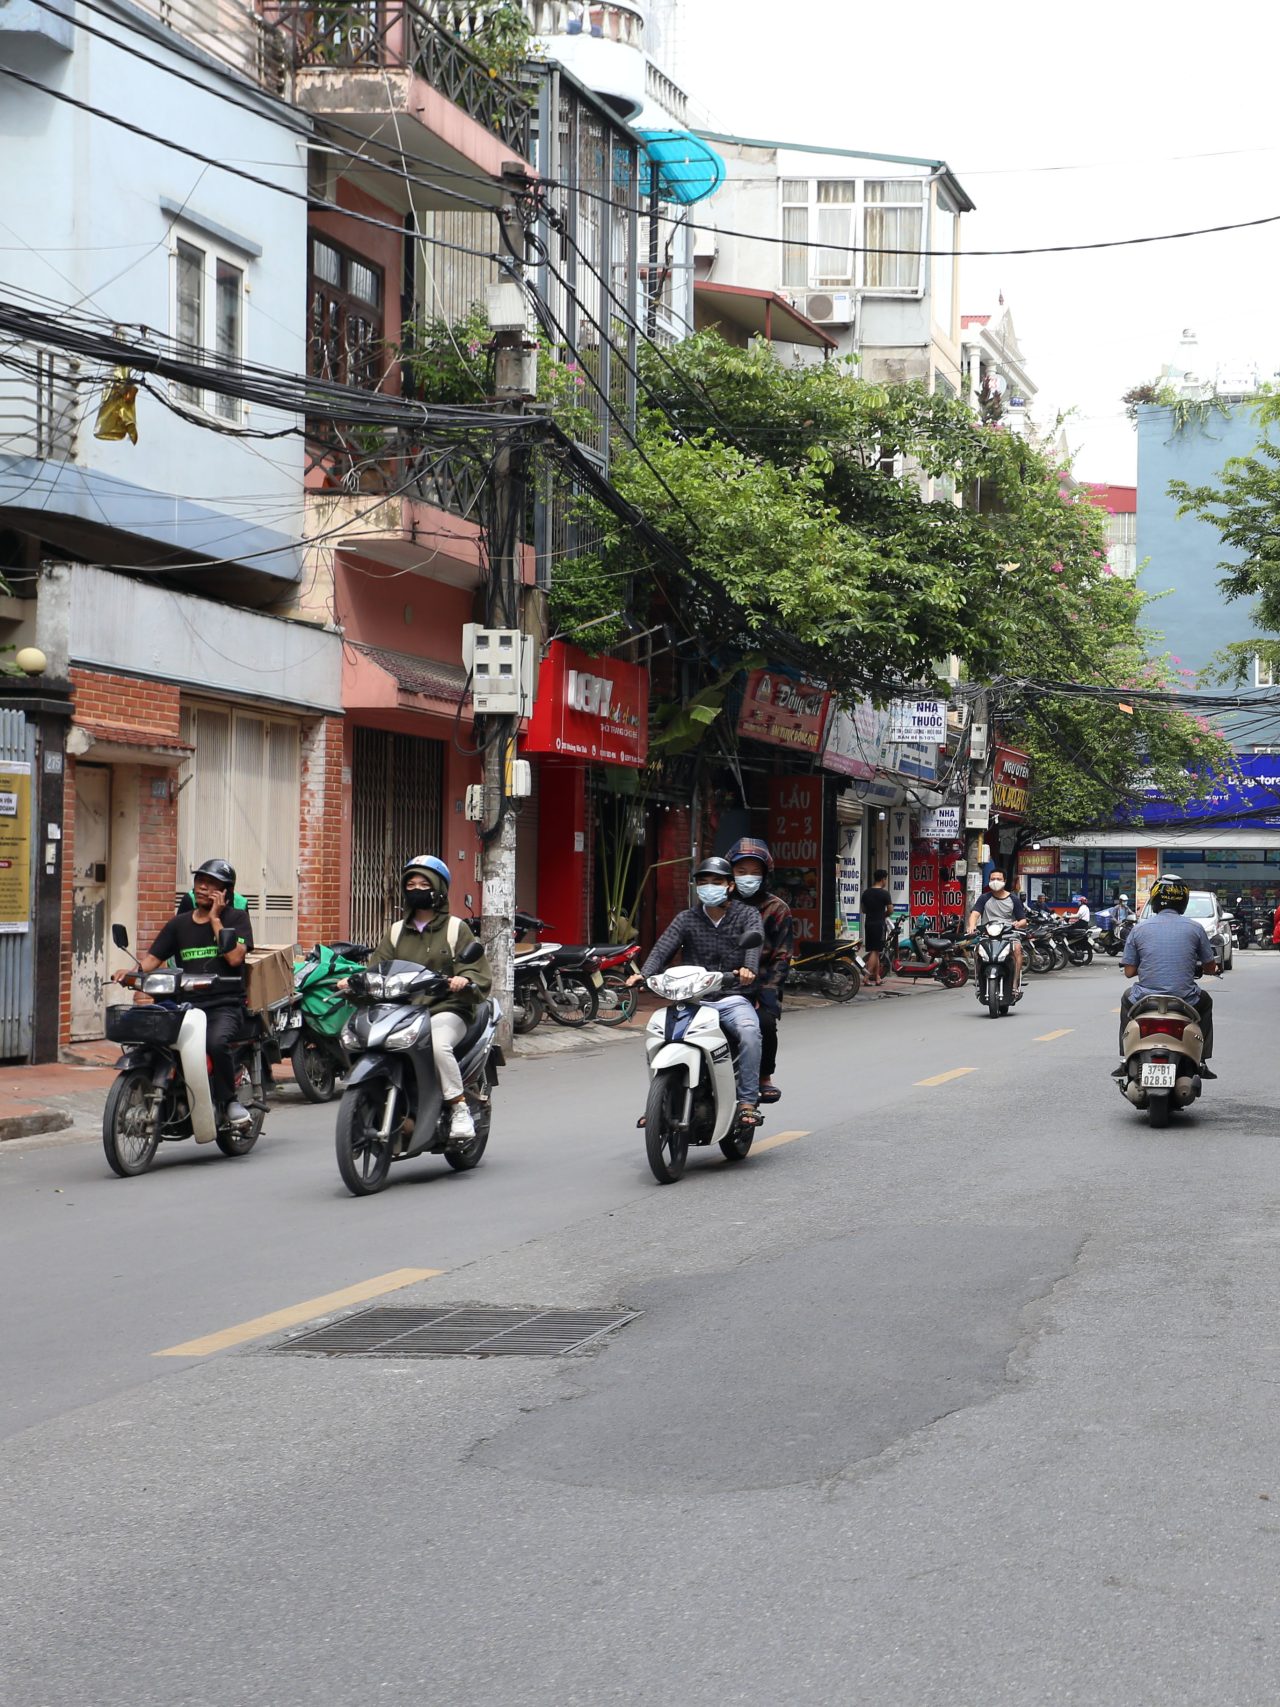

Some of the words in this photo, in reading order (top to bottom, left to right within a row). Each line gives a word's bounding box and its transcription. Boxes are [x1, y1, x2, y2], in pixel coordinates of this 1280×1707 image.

[46, 757, 60, 769] 275
[780, 785, 810, 808] LẨU
[777, 817, 785, 834] 2
[804, 816, 812, 834] 3
[772, 839, 817, 860] NGƯỜI
[914, 861, 933, 881] CẮT
[894, 881, 904, 890] ANH
[843, 897, 855, 905] ANH
[913, 887, 934, 905] TÓC
[1144, 1076, 1172, 1085] 028.61
